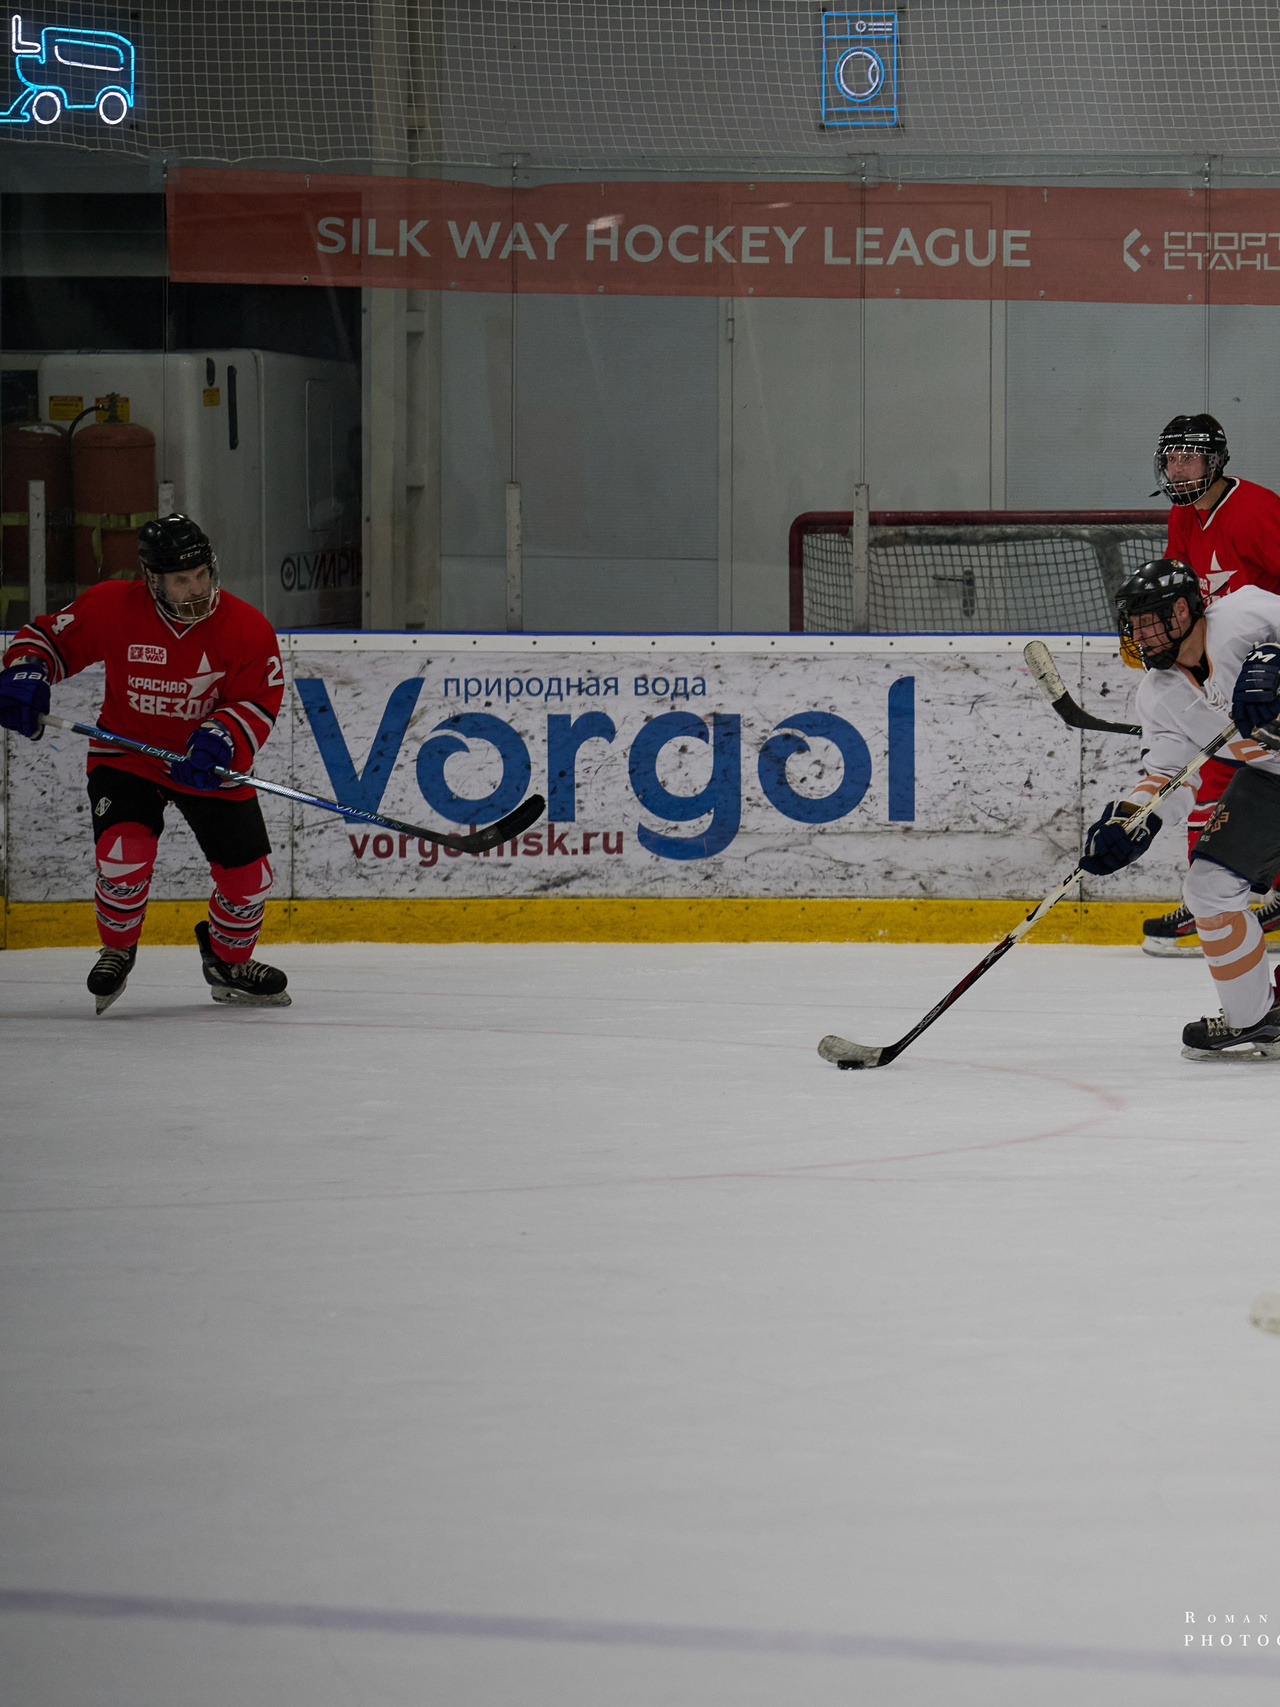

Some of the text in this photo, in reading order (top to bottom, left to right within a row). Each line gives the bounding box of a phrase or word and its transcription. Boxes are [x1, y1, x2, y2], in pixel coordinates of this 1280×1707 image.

[316, 216, 1031, 267] SILK WAY HOCKEY LEAGUE
[144, 647, 164, 656] SILK
[145, 653, 164, 663] WAY
[127, 675, 187, 694] КРАСНАЯ
[443, 676, 707, 704] природная вода
[126, 690, 214, 721] ЗВЕЗДА
[294, 675, 915, 860] Vorgol
